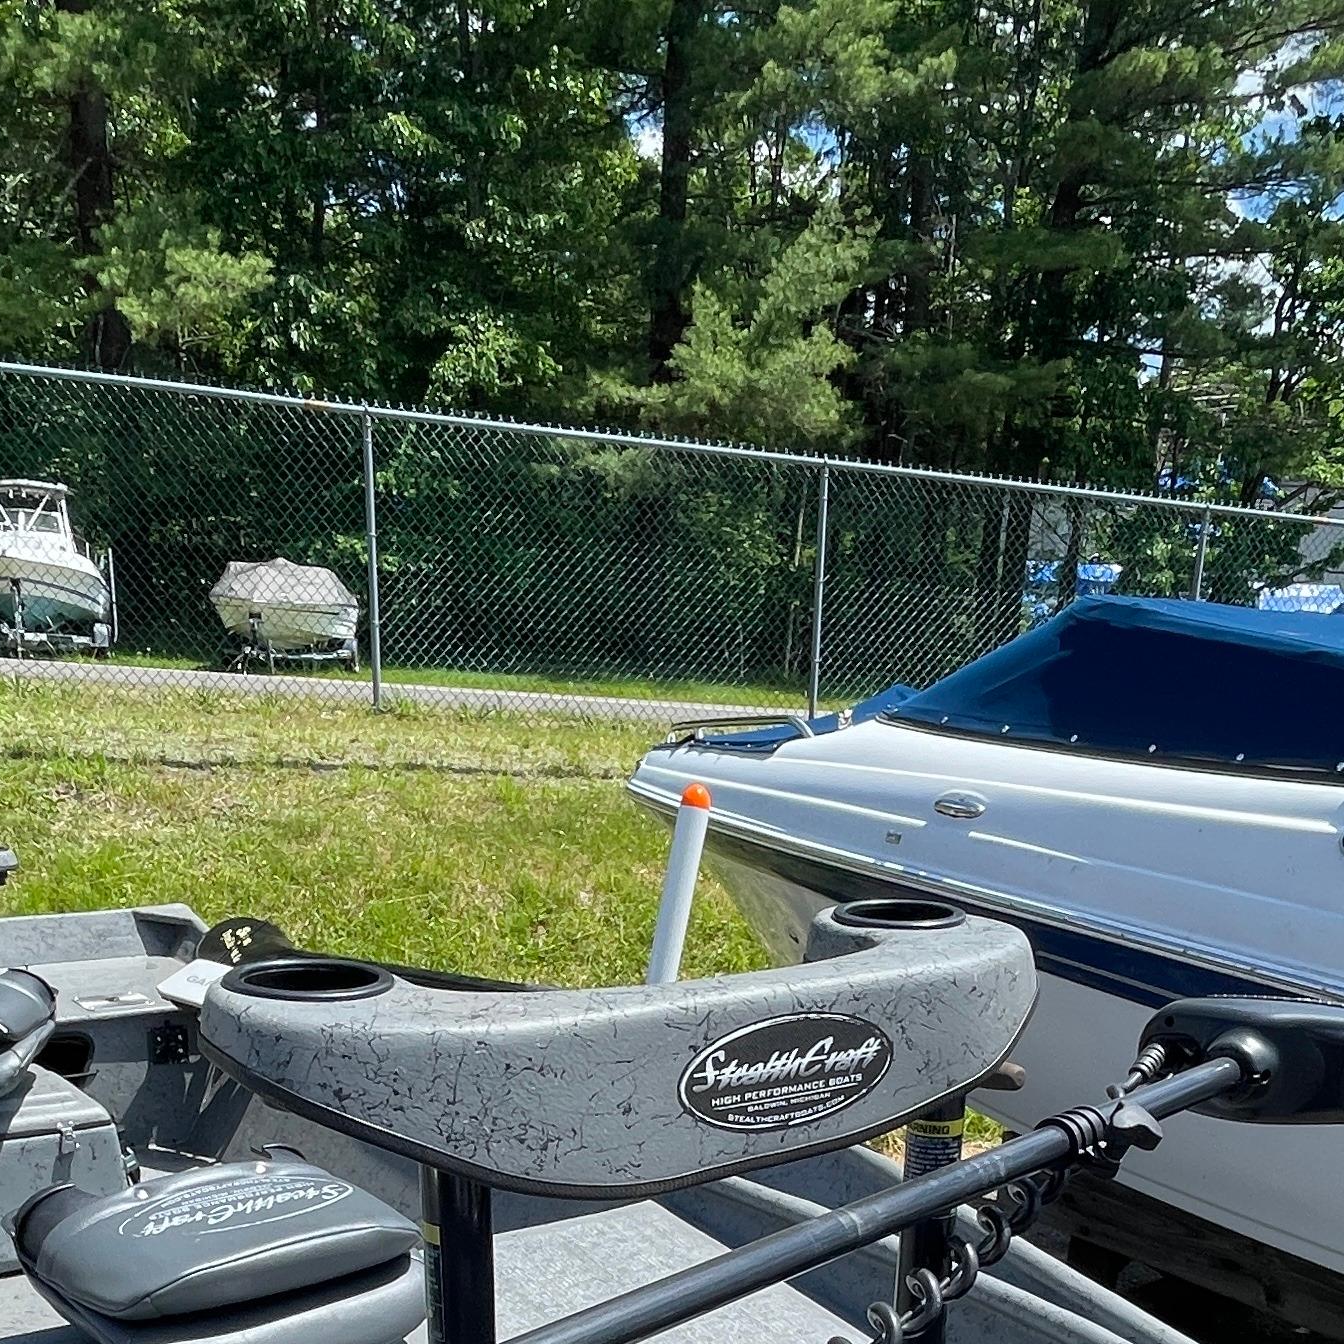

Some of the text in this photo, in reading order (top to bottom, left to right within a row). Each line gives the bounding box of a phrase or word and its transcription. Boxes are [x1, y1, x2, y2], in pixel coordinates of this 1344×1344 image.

[711, 1073, 863, 1107] HIGH PERFORMANCE BOATS
